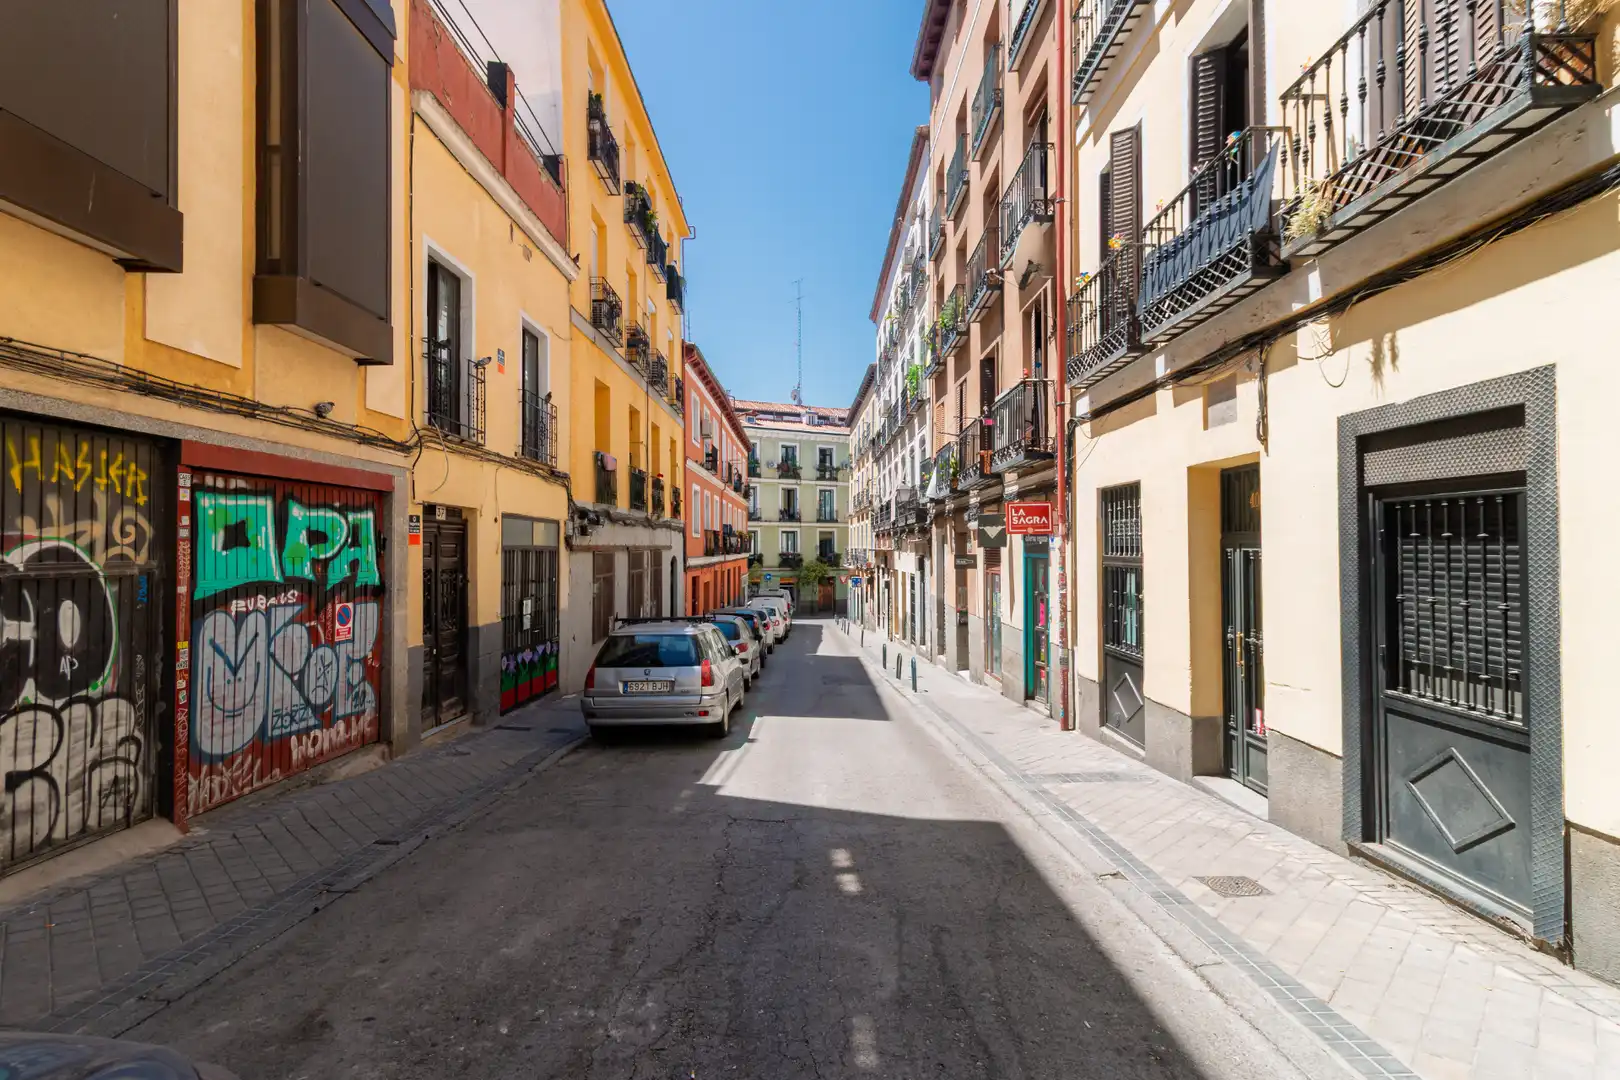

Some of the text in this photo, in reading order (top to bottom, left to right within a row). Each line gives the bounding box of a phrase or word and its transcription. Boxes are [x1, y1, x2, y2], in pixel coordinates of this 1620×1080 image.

[1012, 508, 1025, 516] LA
[1012, 516, 1048, 524] SAGRA
[628, 682, 668, 691] 6921 BJH
